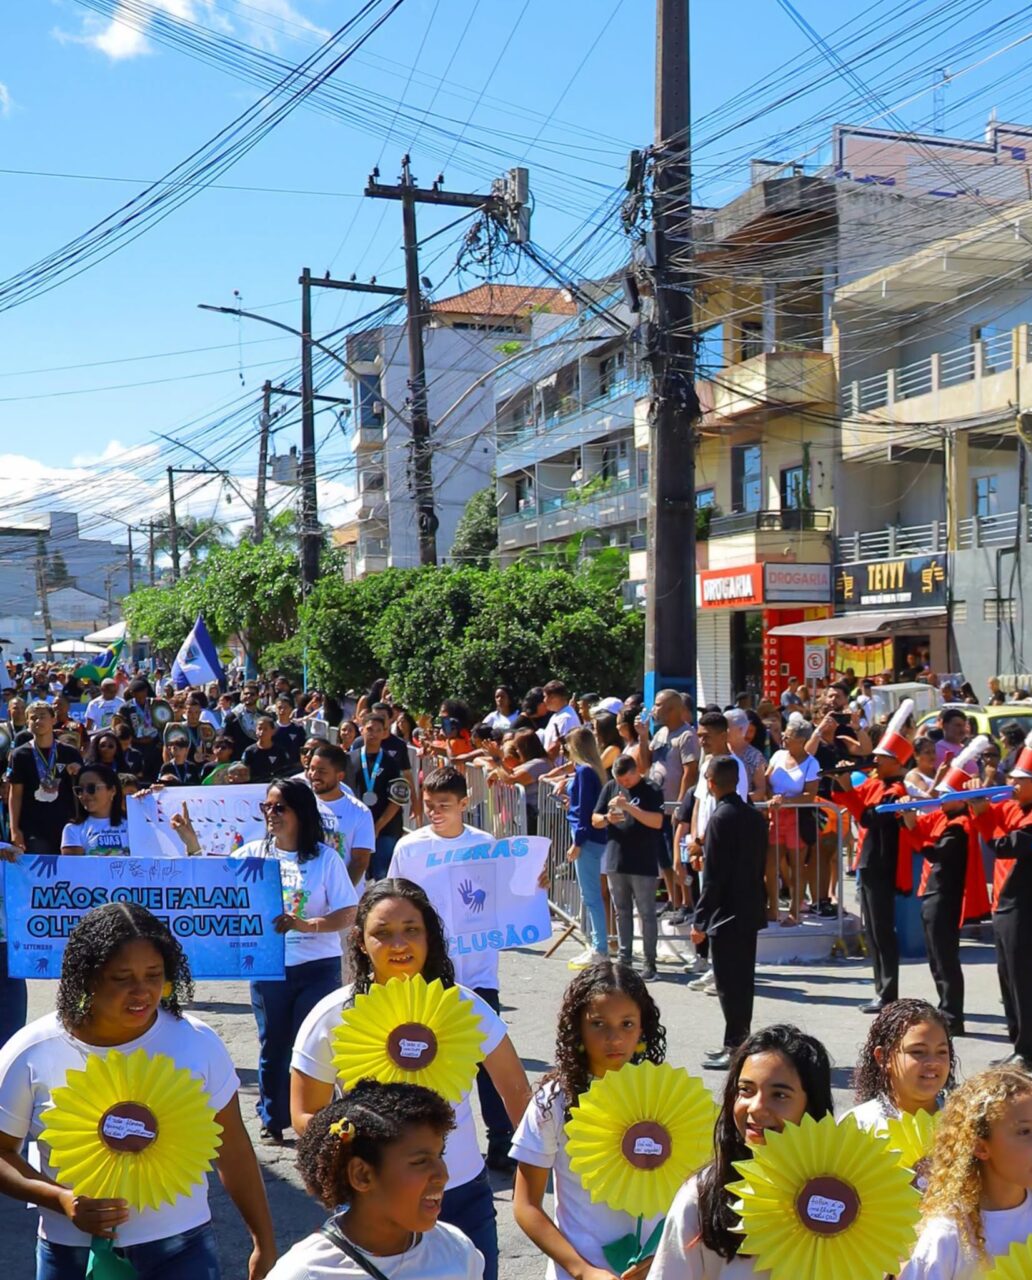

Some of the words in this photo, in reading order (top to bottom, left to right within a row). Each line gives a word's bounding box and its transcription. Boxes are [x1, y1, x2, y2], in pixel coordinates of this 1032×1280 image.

[768, 571, 828, 585] DROGARIA
[426, 837, 529, 868] LIBRAS
[31, 881, 108, 909] MÃOS
[110, 887, 163, 909] QUE
[166, 887, 249, 910] FALAM
[27, 915, 77, 938] OLH
[174, 915, 263, 937] OUVEM
[449, 924, 540, 956] CLUSÃO
